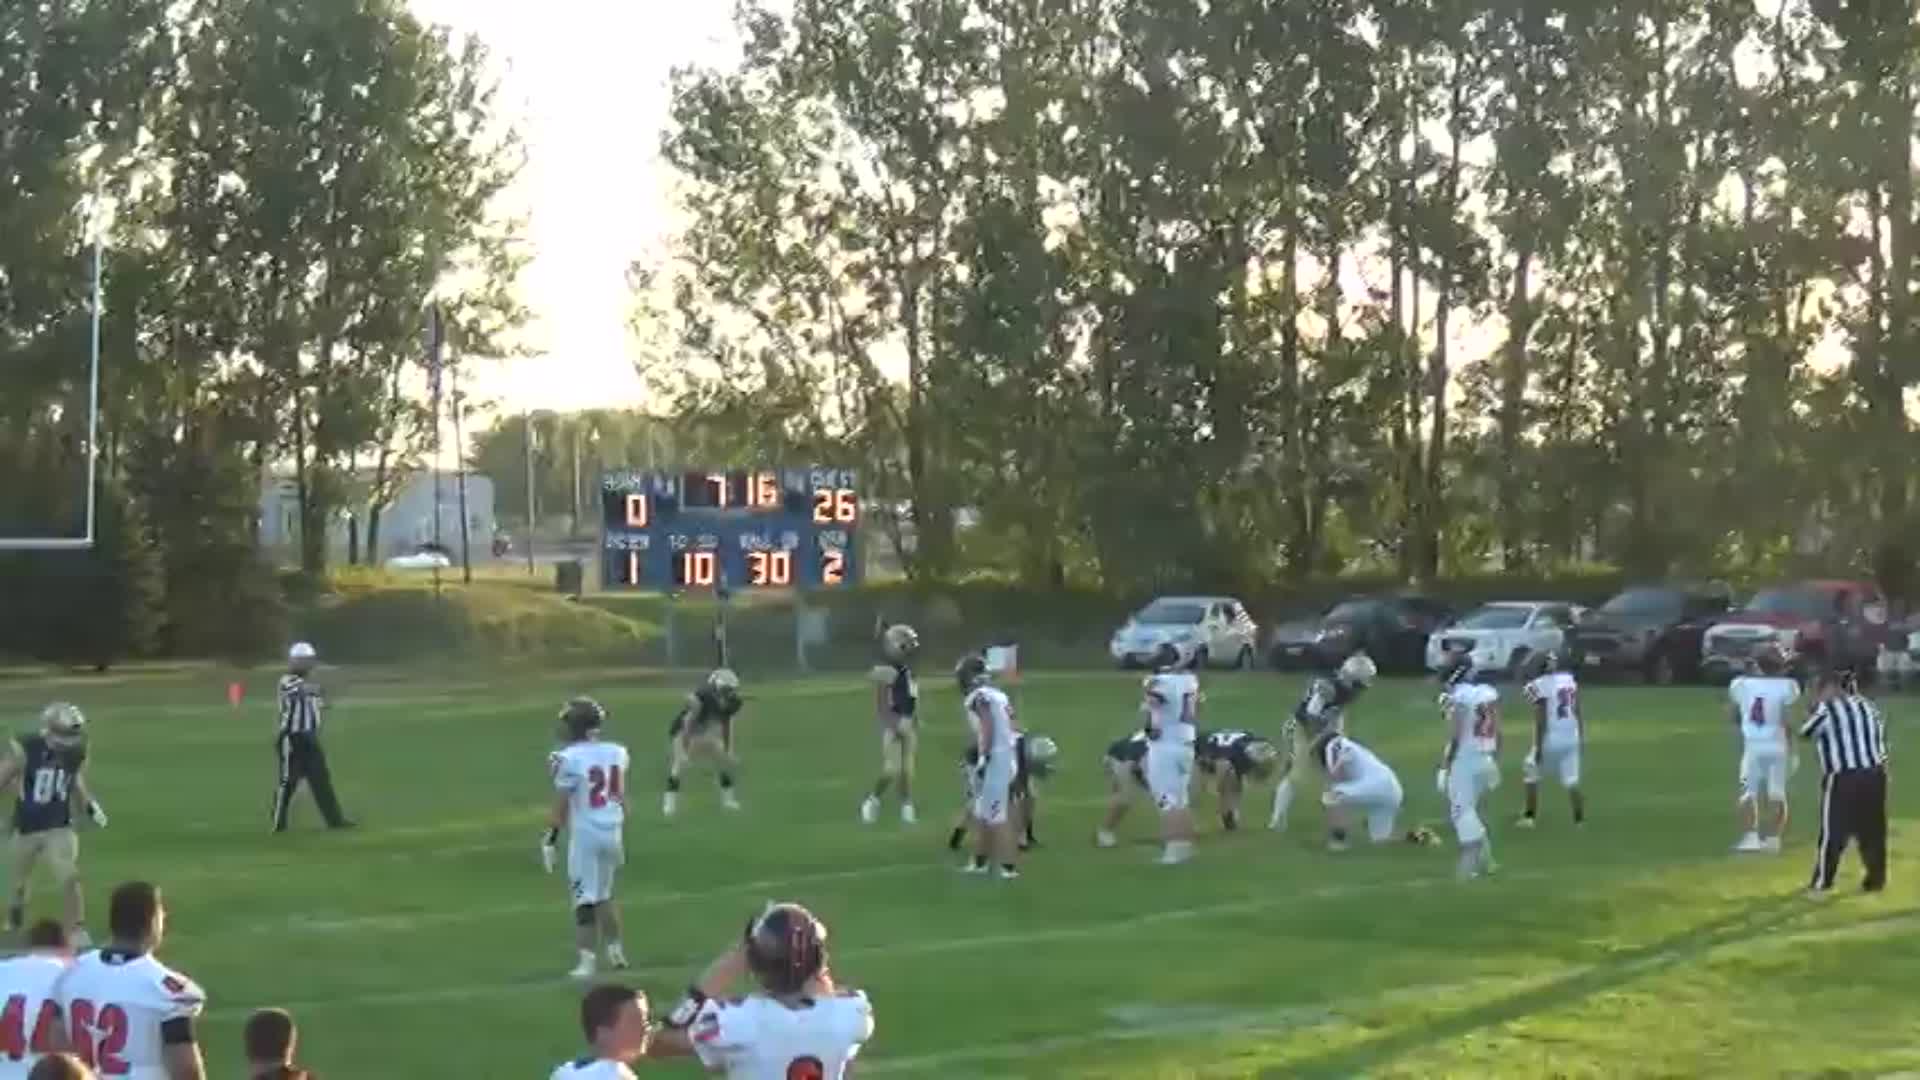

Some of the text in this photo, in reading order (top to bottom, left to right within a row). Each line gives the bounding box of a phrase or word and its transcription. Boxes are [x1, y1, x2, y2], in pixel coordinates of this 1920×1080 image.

[626, 494, 648, 527] 0
[813, 488, 856, 522] 26
[630, 550, 638, 585] 1
[684, 552, 714, 585] 10
[748, 551, 790, 585] 30
[823, 550, 843, 584] 2
[1750, 696, 1766, 726] 4
